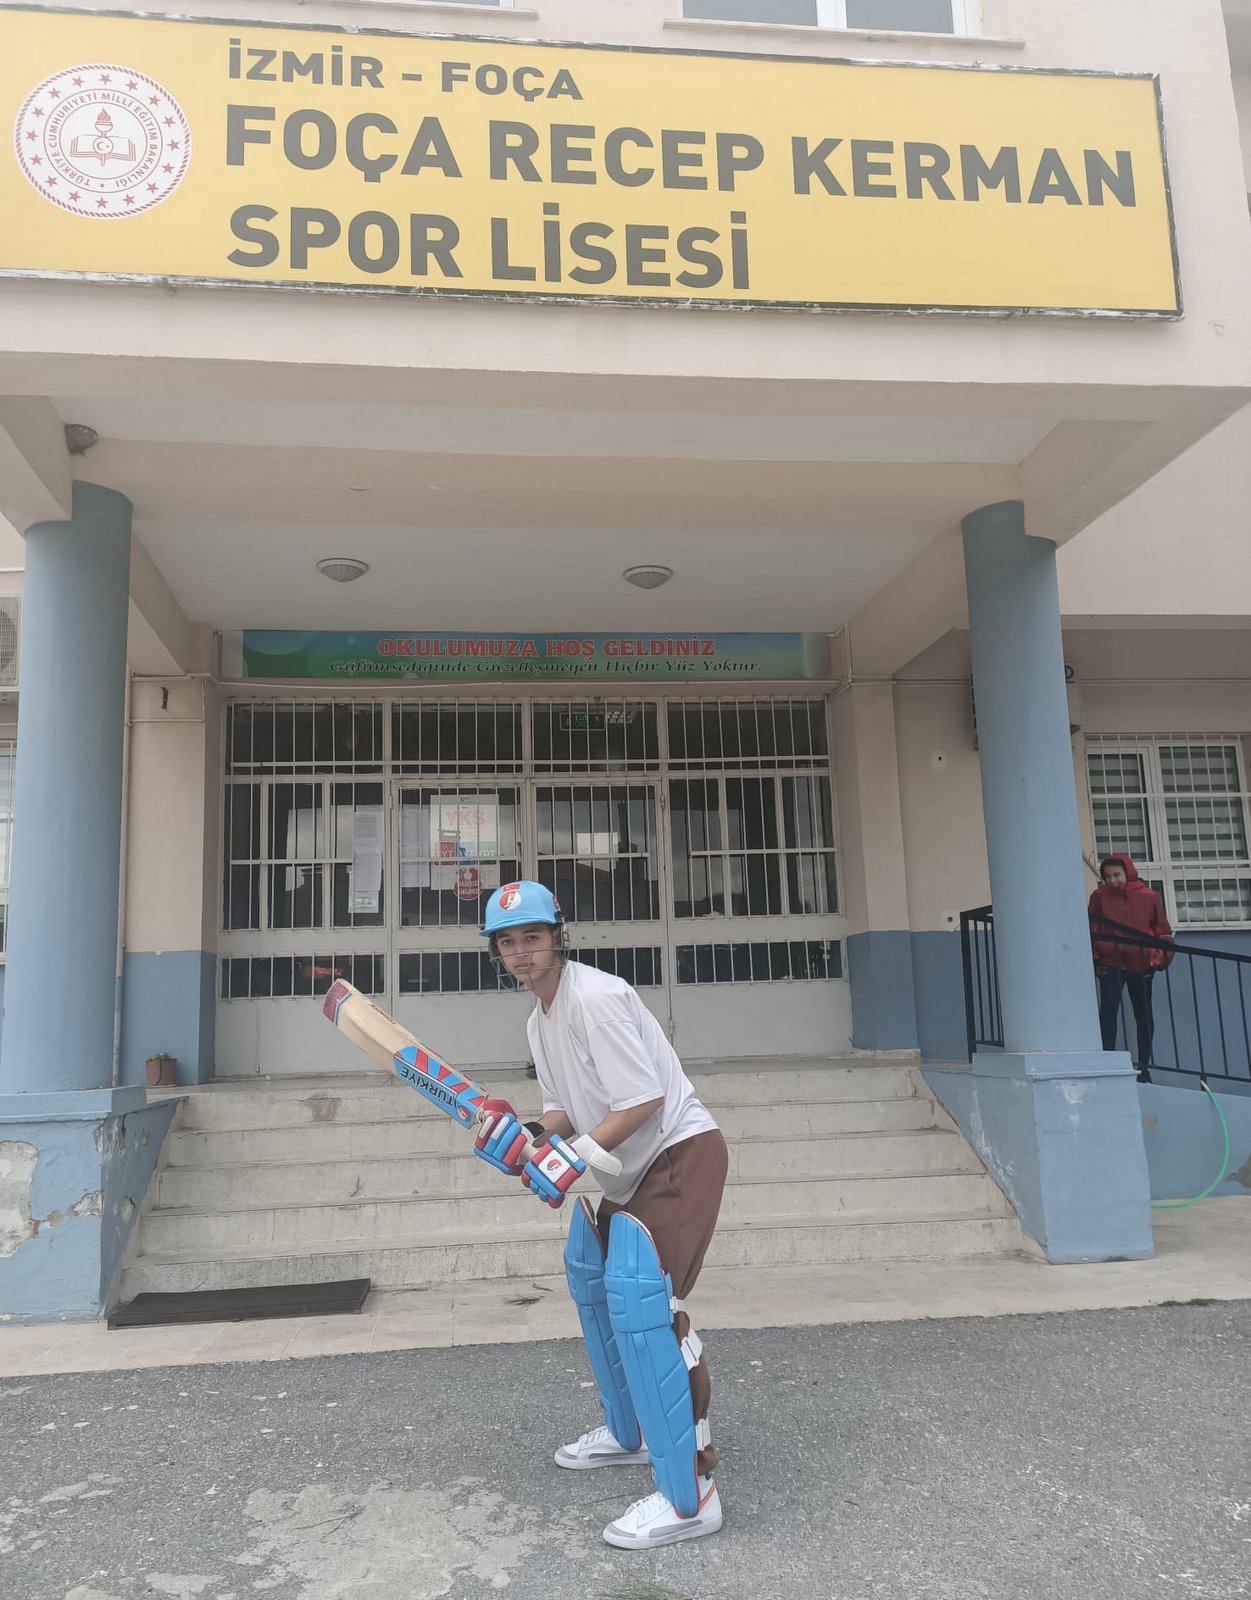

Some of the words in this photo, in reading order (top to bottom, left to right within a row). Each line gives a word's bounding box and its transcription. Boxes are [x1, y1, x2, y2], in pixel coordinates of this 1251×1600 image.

[228, 38, 385, 89] İZMİR
[442, 61, 584, 102] FOÇA
[48, 92, 97, 148] CUMHURİYETİ
[133, 106, 158, 141] EĞİTİM
[51, 151, 91, 187] TÜRKİYE
[115, 144, 158, 188] BAKANLIĞI
[226, 104, 462, 183] FOÇA
[489, 119, 765, 192] RECEP
[791, 136, 1136, 207] KERMAN
[226, 204, 464, 278] SPOR
[491, 202, 750, 290] LİSESİ
[377, 639, 539, 657] OKULUMUZA
[545, 639, 595, 660] HOŞ
[604, 636, 716, 657] GELDİNİZ
[476, 660, 598, 676] Güzelleşmeyen
[606, 659, 659, 674] Hiçbir
[665, 660, 696, 672] Yüz
[702, 659, 762, 672] Yoktur.
[447, 810, 486, 826] YKS
[400, 1066, 454, 1107] TÜRKİYE
